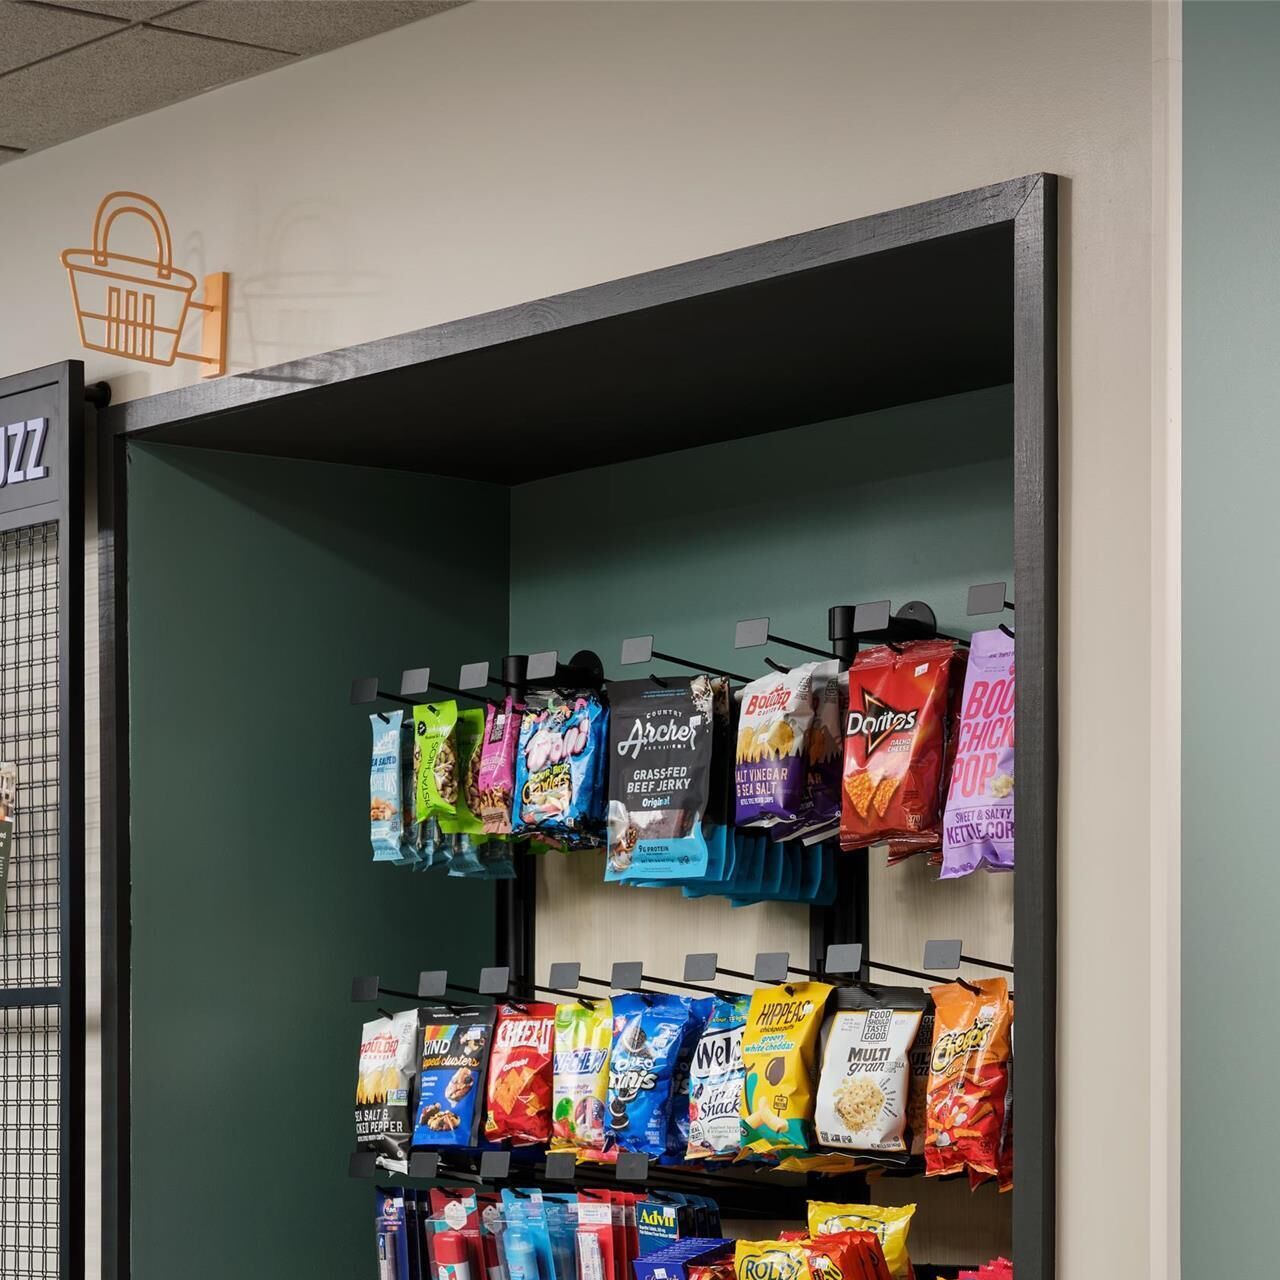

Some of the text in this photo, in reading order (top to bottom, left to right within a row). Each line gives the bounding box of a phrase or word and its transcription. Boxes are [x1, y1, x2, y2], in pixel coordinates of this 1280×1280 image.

[964, 676, 1014, 721] BOO
[646, 709, 682, 719] COUNTRY
[847, 709, 918, 736] Doritos
[617, 718, 697, 759] Archer
[960, 716, 1014, 753] CHICK
[633, 767, 687, 781] GRASS-FED
[749, 767, 788, 781] VINEGAR
[951, 752, 997, 801] POP
[627, 778, 691, 793] BEEF JERKY
[742, 782, 777, 796] SEA SALT
[642, 797, 670, 807] Original
[955, 808, 1012, 824] SWEET & SALTY
[946, 822, 1014, 846] KETTLE COR
[756, 1000, 809, 1026] HIPPEAS
[869, 1010, 891, 1019] FOOD
[864, 1032, 887, 1040] GOOD
[866, 1025, 888, 1033] TASTE
[761, 1034, 785, 1044] groovy
[423, 1040, 450, 1056] KIND
[744, 1041, 794, 1052] white cheddar
[441, 1055, 480, 1067] clusters
[847, 1047, 891, 1063] MULTI
[615, 1057, 655, 1071] OREO
[847, 1062, 884, 1076] grain
[364, 1109, 381, 1121] SALT
[700, 1100, 741, 1120] Snack
[370, 1121, 403, 1133] PEPPER
